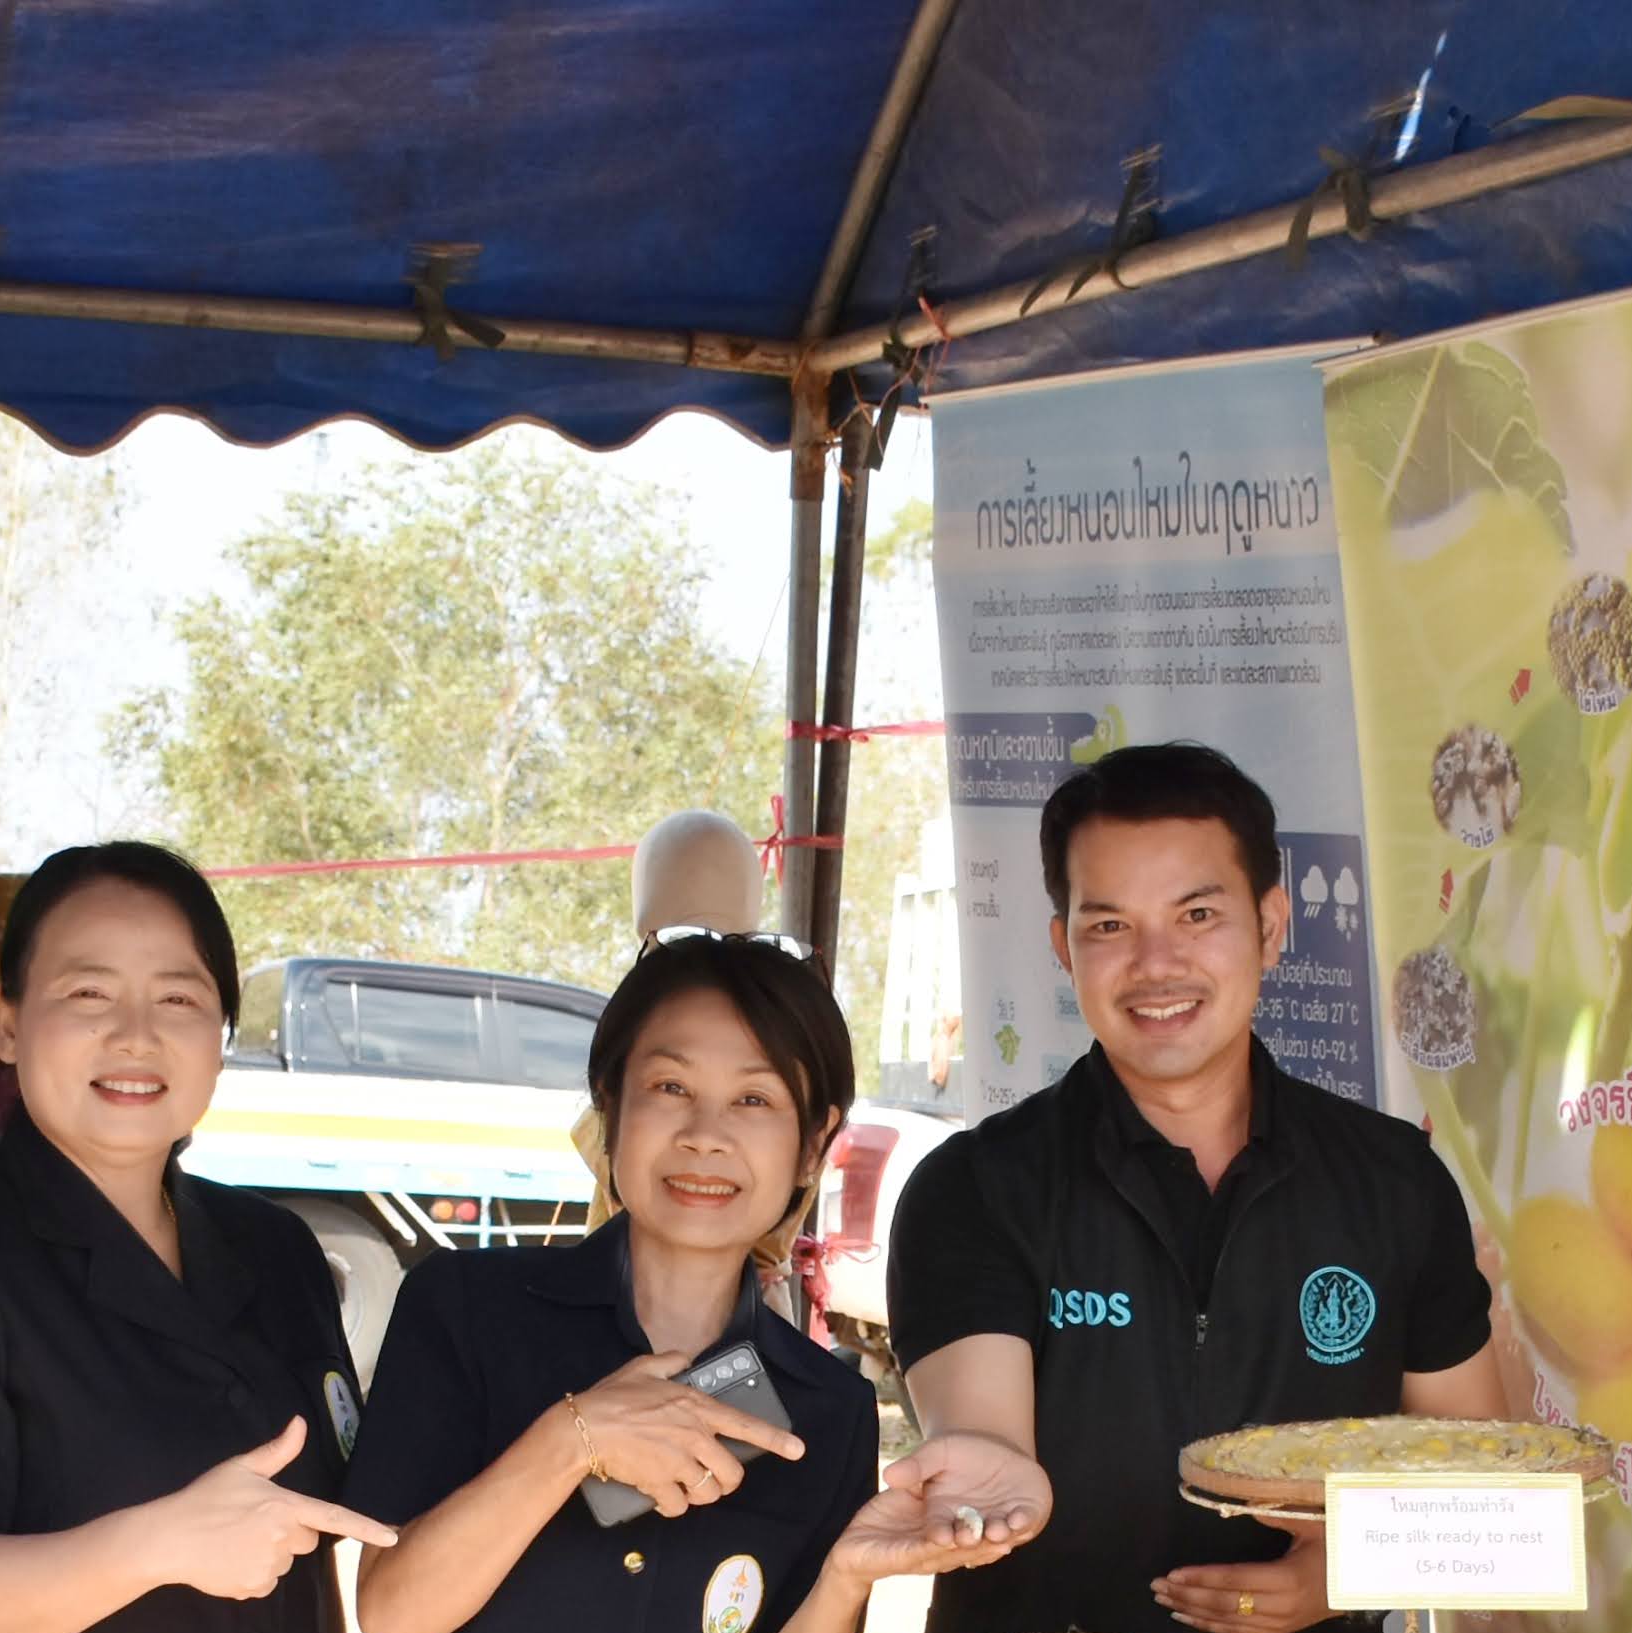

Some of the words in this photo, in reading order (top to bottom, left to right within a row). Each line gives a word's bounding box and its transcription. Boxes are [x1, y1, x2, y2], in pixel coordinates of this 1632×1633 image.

[976, 450, 1319, 556] การเลี้ยงหนอนไหมในฤดูหนาว
[1048, 1286, 1133, 1330] QSDS
[1390, 1495, 1515, 1519] ไหมสุกพร้อมทำรัง
[1364, 1529, 1400, 1546] Ripe
[1405, 1529, 1432, 1545] silk
[1436, 1530, 1481, 1548] ready
[1487, 1531, 1505, 1545] to
[1509, 1531, 1544, 1545] nest
[1415, 1558, 1448, 1575] (5-6
[1452, 1558, 1496, 1577] Days)
